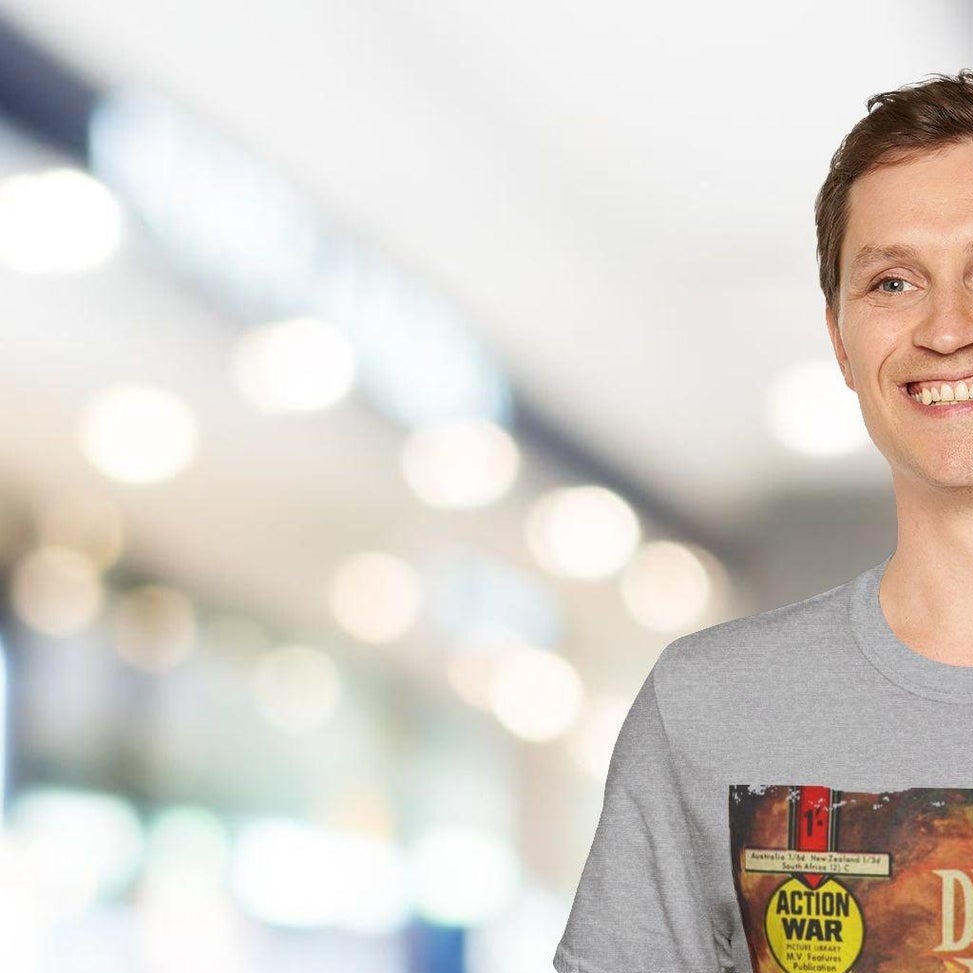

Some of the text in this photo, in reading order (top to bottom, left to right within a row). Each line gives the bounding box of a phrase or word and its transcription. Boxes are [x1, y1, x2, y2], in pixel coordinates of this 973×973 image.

[751, 852, 785, 861] Australia
[810, 854, 826, 862] New
[828, 855, 860, 864] Zealand
[782, 862, 803, 870] South
[804, 863, 827, 871] Africa
[776, 890, 850, 917] ACTION
[781, 918, 843, 942] WAR
